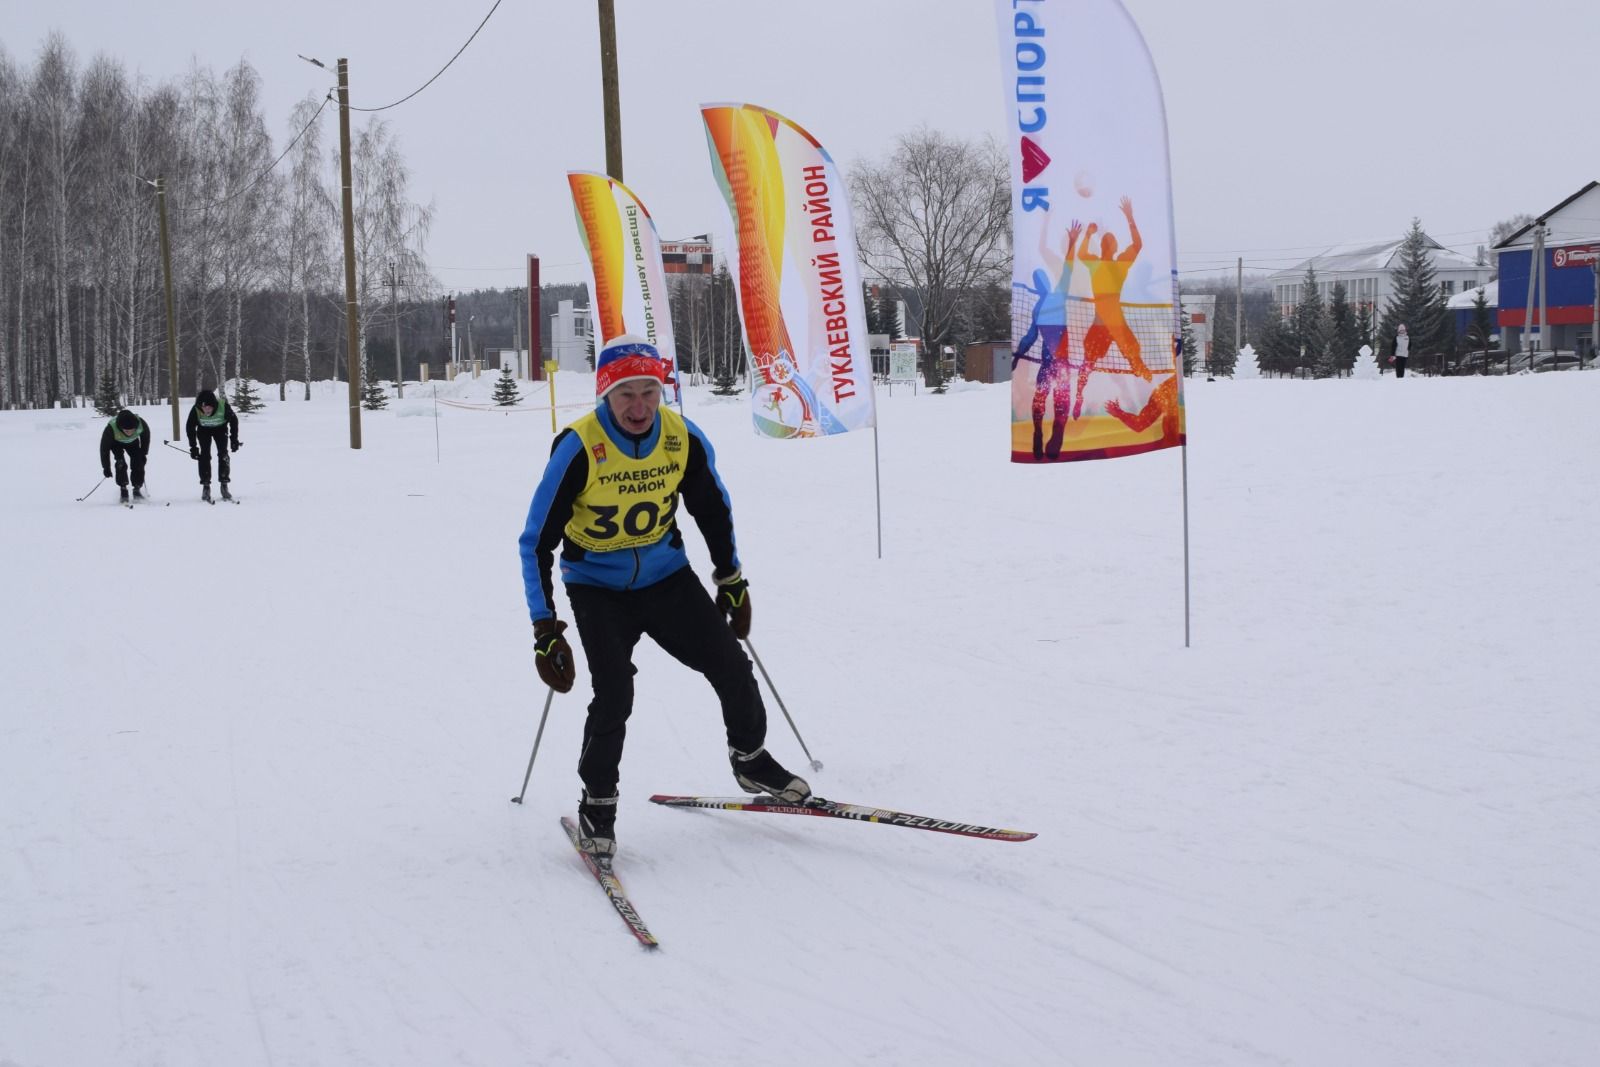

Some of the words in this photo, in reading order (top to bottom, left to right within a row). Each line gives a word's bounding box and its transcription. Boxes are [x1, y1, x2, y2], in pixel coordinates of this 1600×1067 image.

[803, 165, 836, 243] РАЙОН
[1022, 187, 1050, 213] Я
[811, 252, 856, 404] ТУКАЕВСКИЙ
[618, 479, 666, 495] РАЙОН
[765, 805, 812, 815] PELTONEN
[892, 814, 999, 835] PELTONEN
